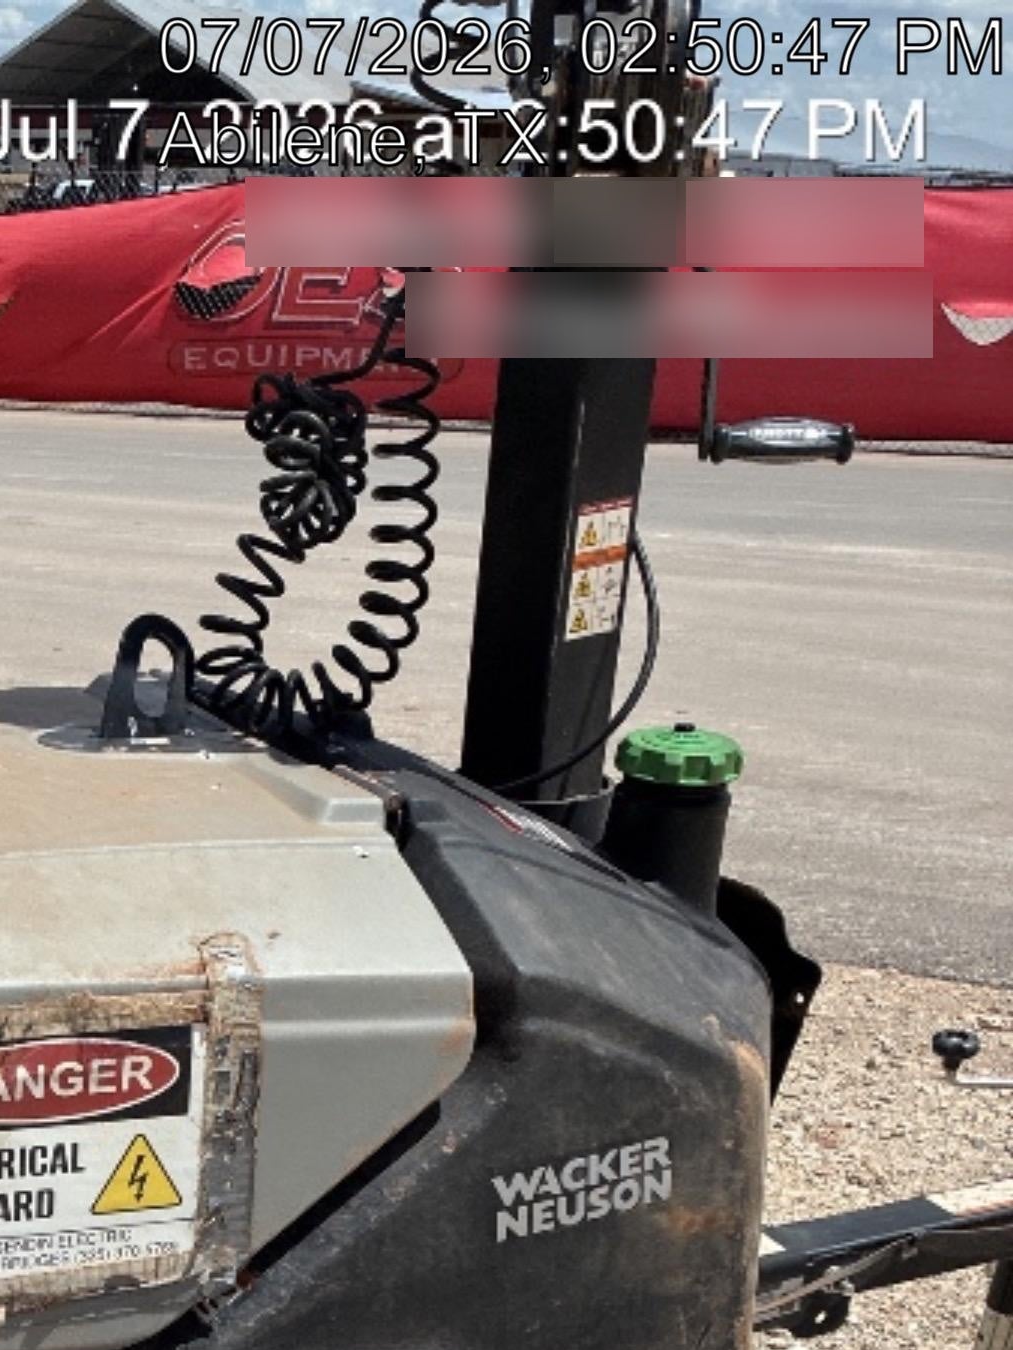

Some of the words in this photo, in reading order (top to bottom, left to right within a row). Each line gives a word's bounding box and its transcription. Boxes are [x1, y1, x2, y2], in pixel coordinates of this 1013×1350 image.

[183, 345, 439, 373] EQUIPM
[491, 1136, 672, 1207] WACKER
[496, 1167, 673, 1243] NEUSON
